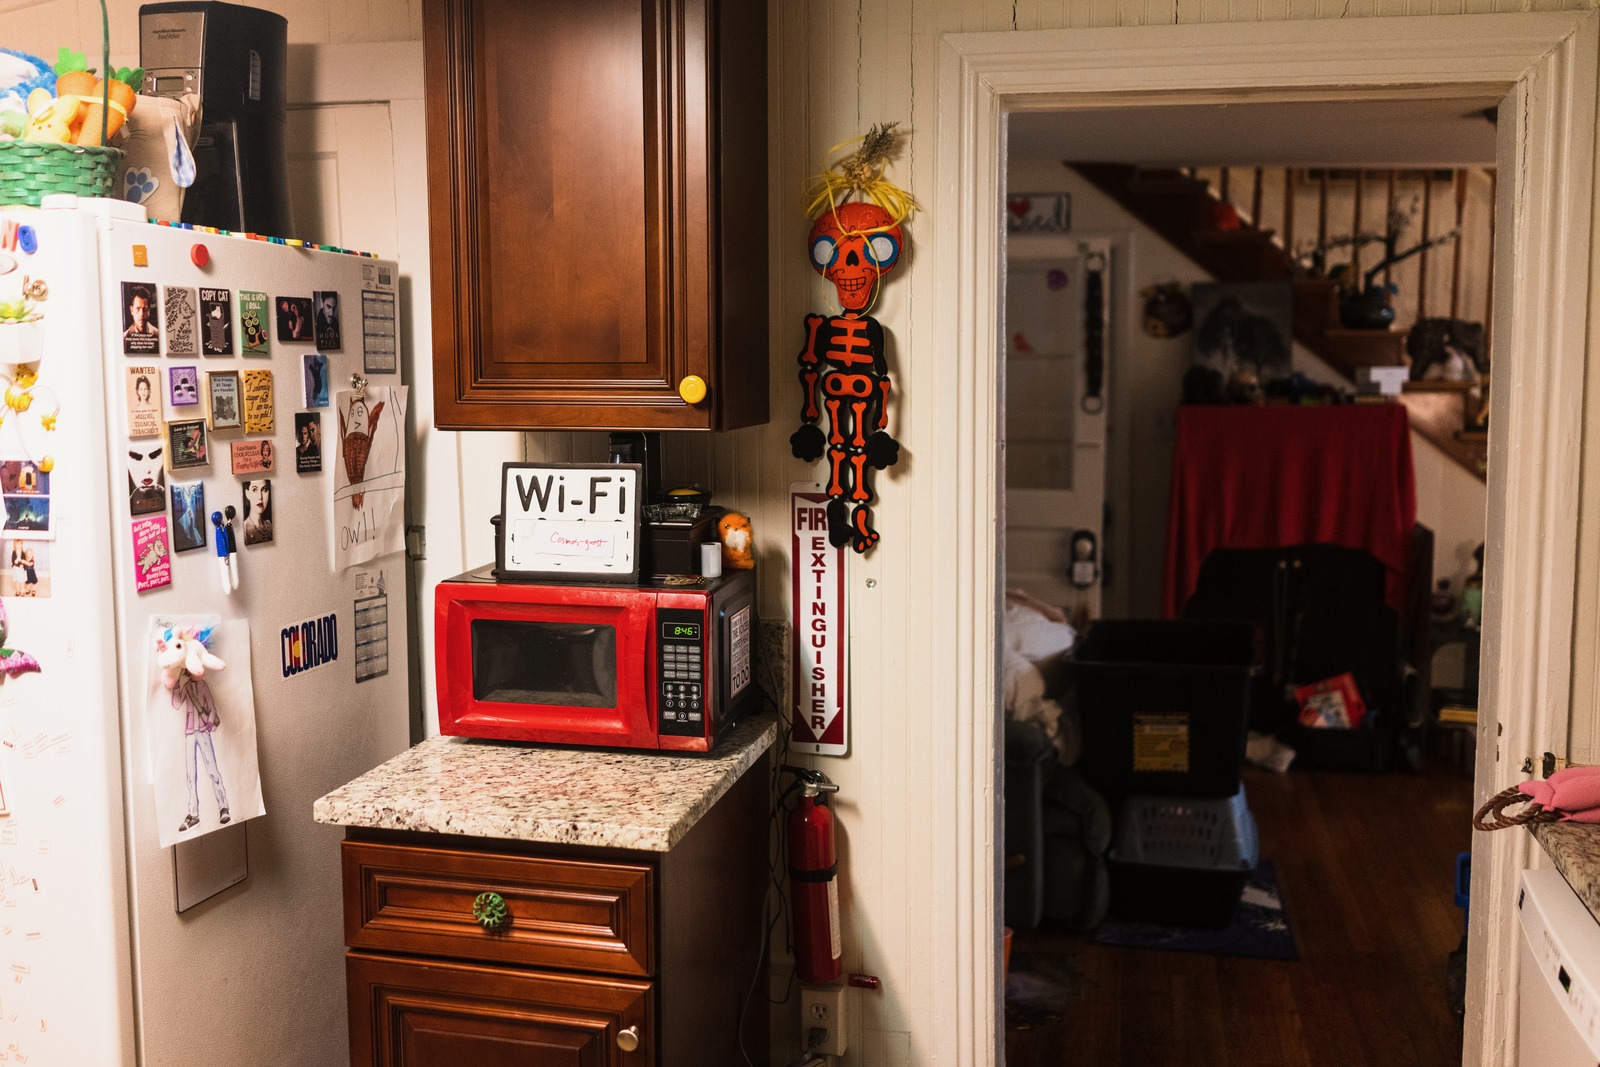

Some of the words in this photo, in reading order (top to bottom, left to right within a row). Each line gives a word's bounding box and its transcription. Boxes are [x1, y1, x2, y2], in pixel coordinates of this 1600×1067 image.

[201, 290, 216, 301] COPY
[217, 291, 229, 302] CAT
[130, 366, 155, 374] WANTED
[516, 475, 626, 514] Wi-Fi
[797, 507, 827, 531] FIR
[674, 626, 693, 636] 8:46
[811, 536, 827, 730] EXTINGUISHER
[281, 613, 338, 678] COLORADO
